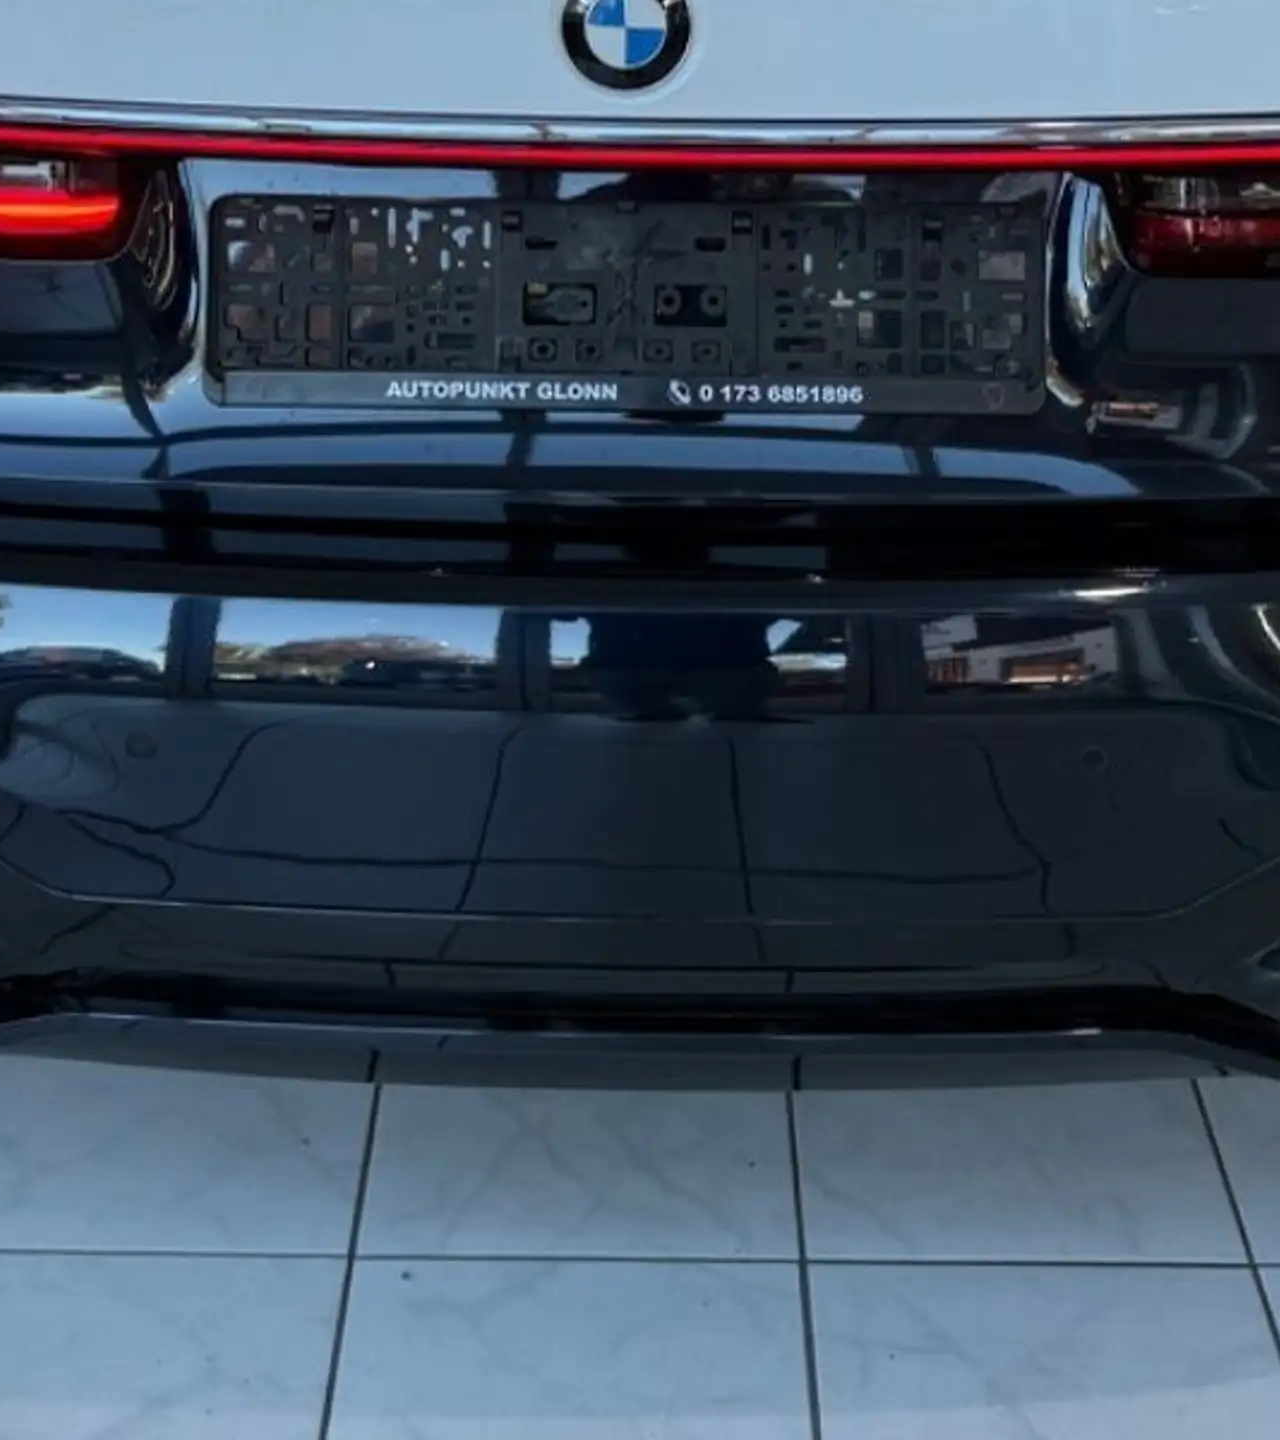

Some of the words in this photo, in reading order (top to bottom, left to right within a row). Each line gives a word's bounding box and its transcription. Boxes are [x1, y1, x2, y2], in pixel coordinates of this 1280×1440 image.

[385, 380, 531, 401] AUTOPUNKT
[536, 380, 619, 402] GLONN
[720, 383, 762, 404] 173
[767, 384, 866, 406] 6851896
